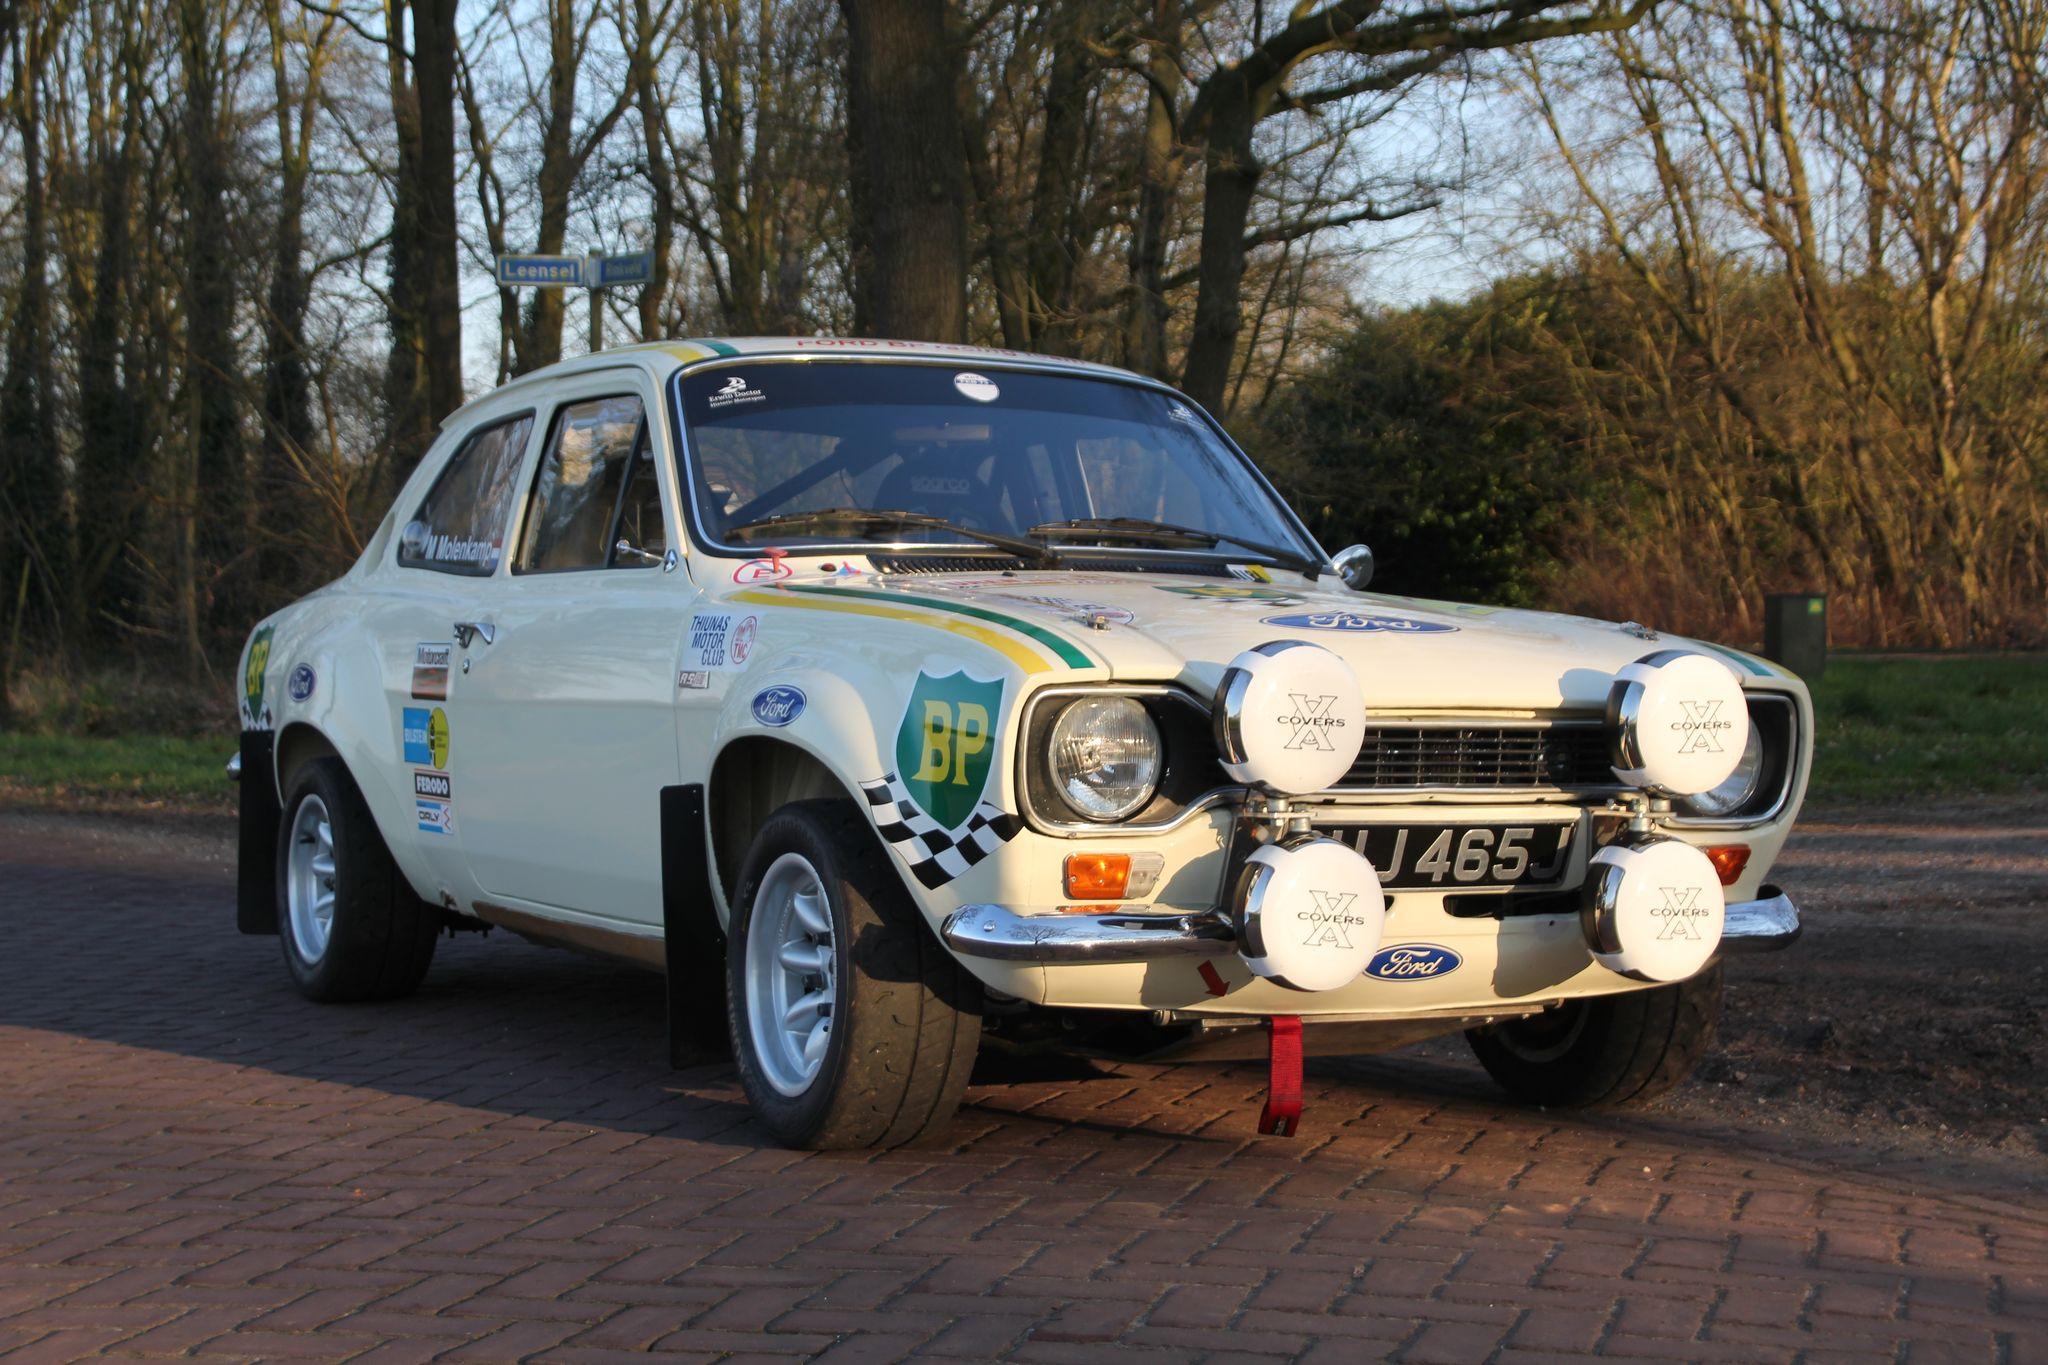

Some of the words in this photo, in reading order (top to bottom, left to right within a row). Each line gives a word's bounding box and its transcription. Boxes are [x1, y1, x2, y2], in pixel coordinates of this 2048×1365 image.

[504, 262, 576, 278] Leensel
[796, 339, 878, 348] FORD
[734, 389, 762, 398] Doctor
[435, 534, 493, 568] Molenkamp
[690, 615, 731, 632] THIUNAS
[1306, 608, 1421, 631] Ford
[692, 632, 725, 649] MOTOR
[701, 648, 725, 666] CLUB
[248, 640, 271, 696] BP
[759, 689, 796, 718] Ford
[1276, 715, 1346, 727] COVERS
[1670, 720, 1732, 731] COVERS
[911, 699, 990, 787] BP
[416, 774, 449, 796] FERODO
[1414, 827, 1573, 883] 465J
[1296, 911, 1366, 926] COVERS
[1649, 907, 1710, 918] COVERS
[1379, 949, 1444, 978] Ford
